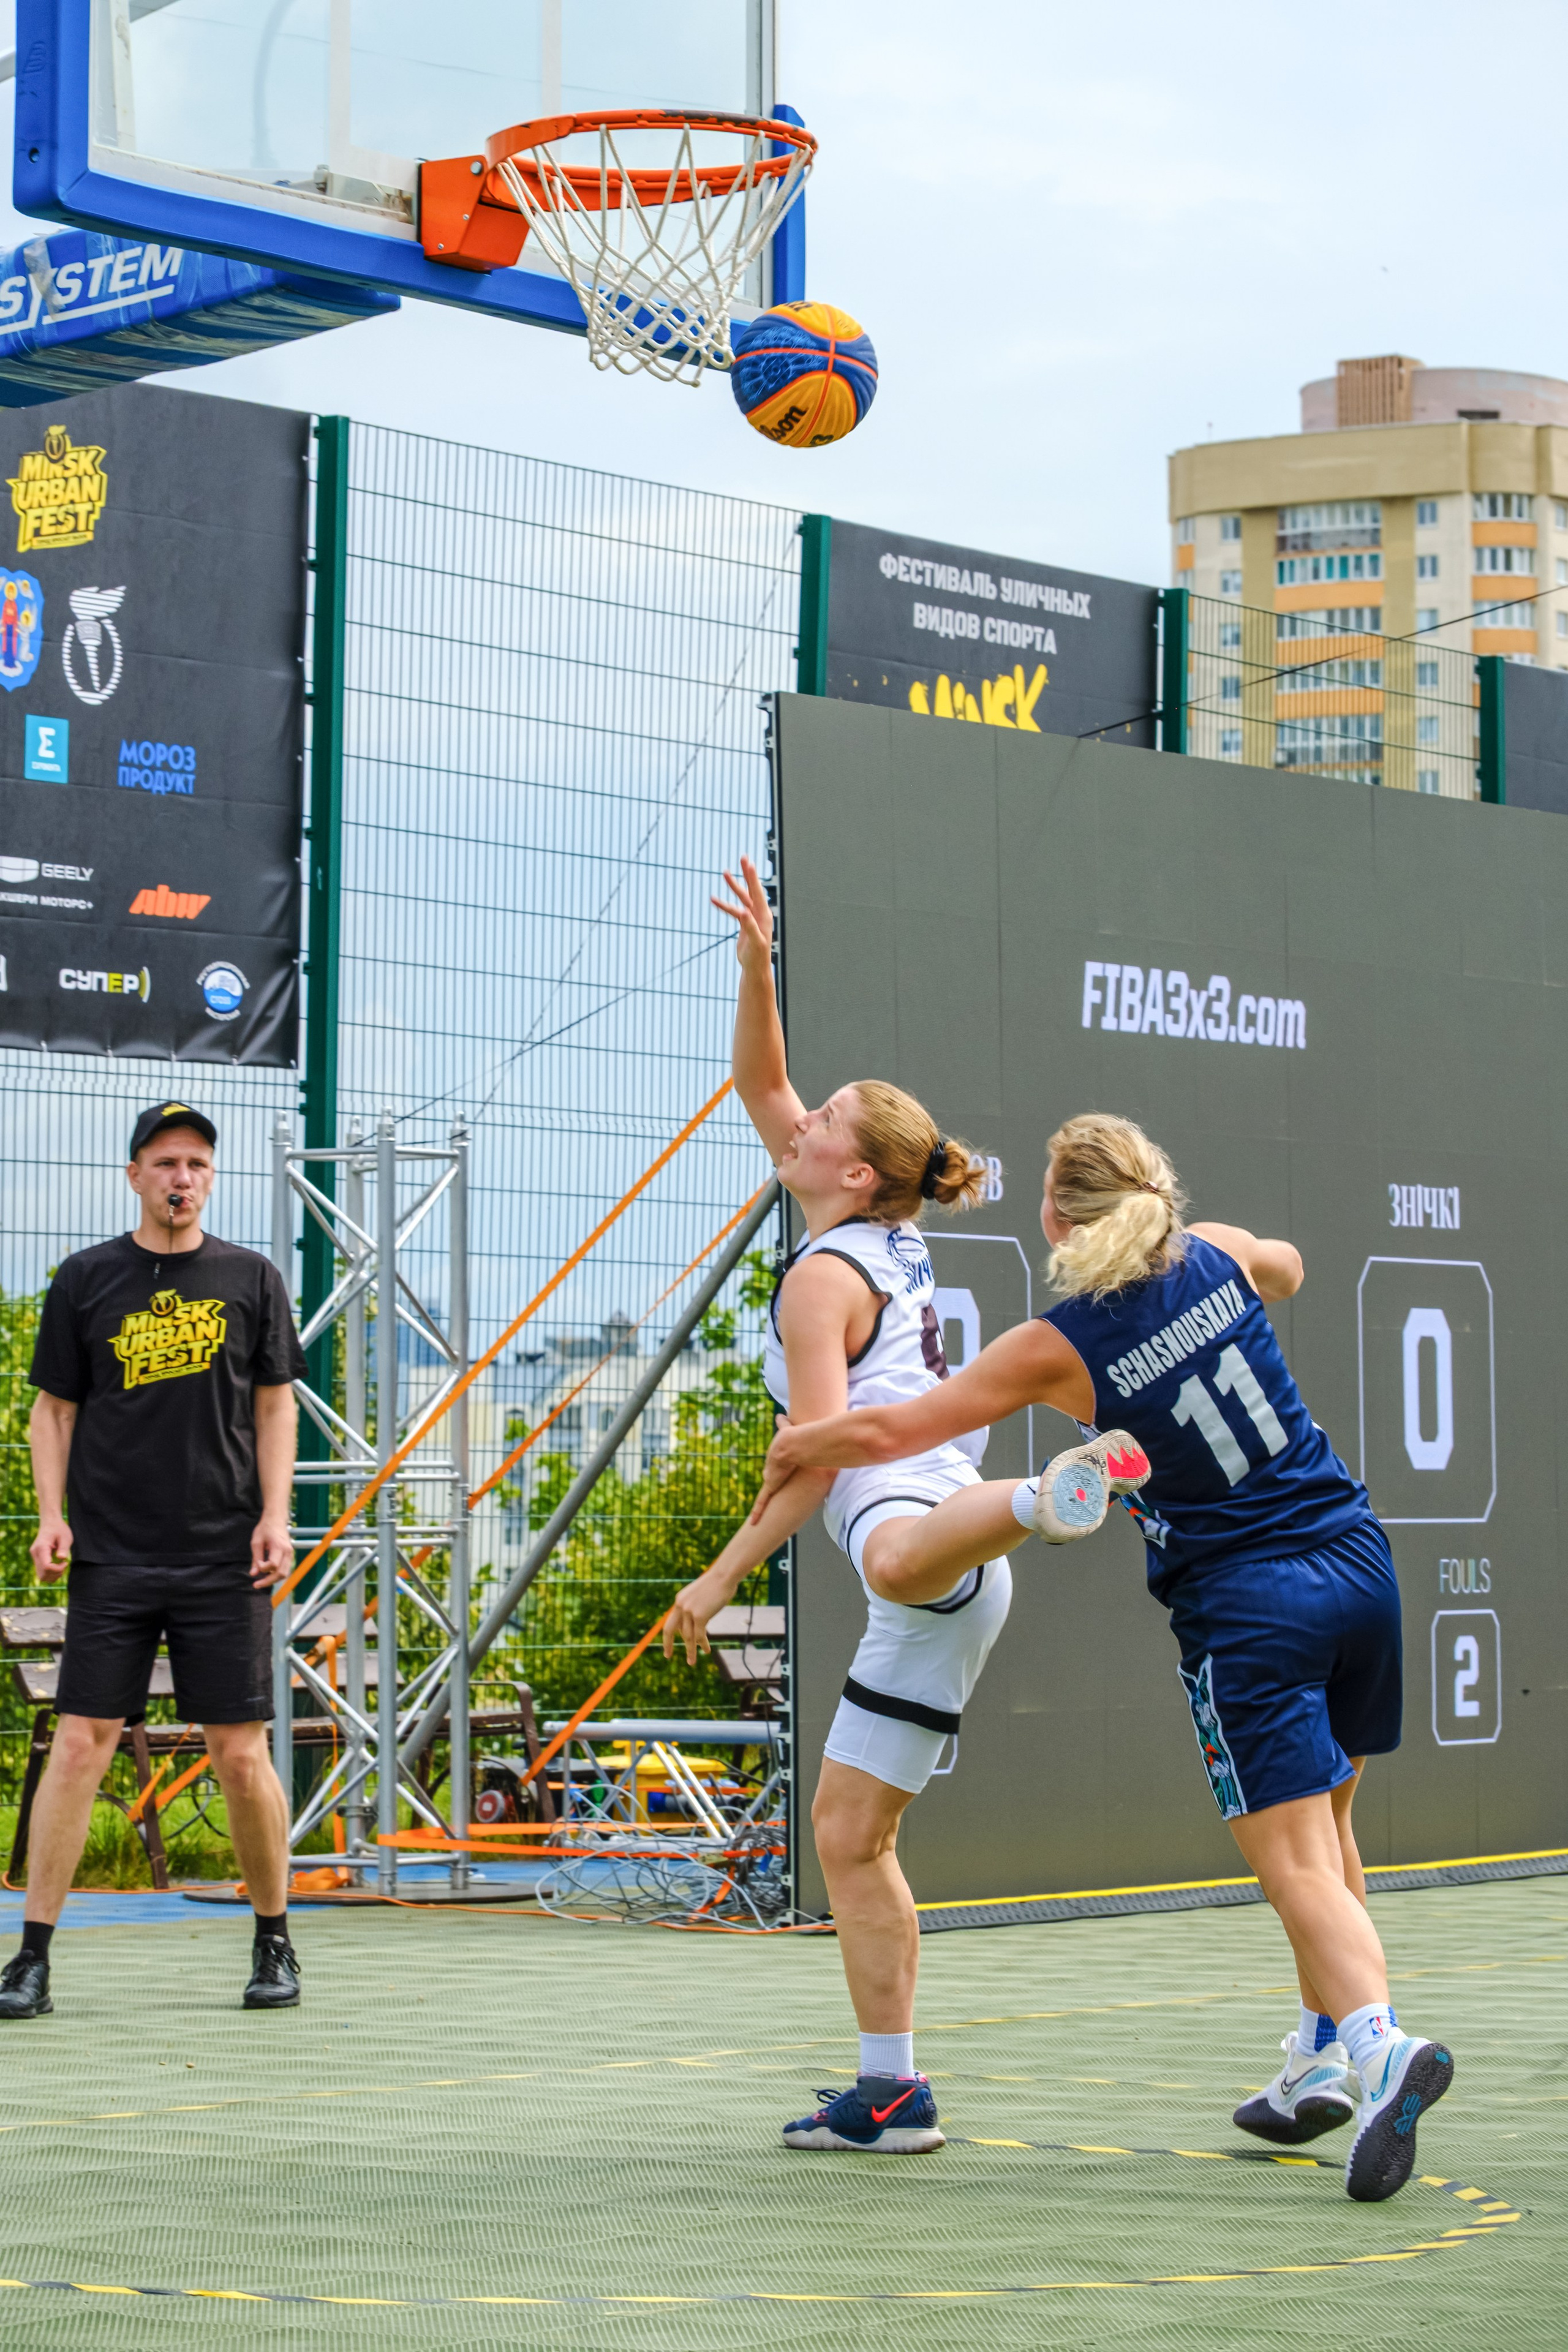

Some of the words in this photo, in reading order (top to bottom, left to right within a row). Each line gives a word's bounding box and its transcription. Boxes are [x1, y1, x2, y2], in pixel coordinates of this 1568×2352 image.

[22, 449, 99, 481] MINSK
[17, 473, 101, 510] URBAN
[25, 502, 94, 542] FEST
[879, 552, 997, 600] ФЕСТИВАЛЬ
[1000, 577, 1091, 619] УЛИЧНЫХ
[913, 602, 981, 639] ВИДОВ
[983, 617, 1058, 655] СПОРТА
[119, 739, 197, 772] МОРОЗ
[117, 766, 195, 796] ПРОДУКТ
[42, 863, 94, 881] GEELY
[59, 968, 140, 994] СУПЕР
[1082, 960, 1306, 1049] FIBA3x3.com
[1388, 1183, 1460, 1229] ЗНІЧКІ
[119, 1319, 219, 1357] URBAN
[125, 1302, 216, 1336] MINSK
[1106, 1279, 1247, 1398] SCHASNOUSKAYA
[130, 1340, 210, 1382] FEST
[1403, 1308, 1454, 1470] 0
[1170, 1343, 1289, 1487] 11
[1439, 1558, 1491, 1594] FOULS
[1453, 1635, 1480, 1717] 2
